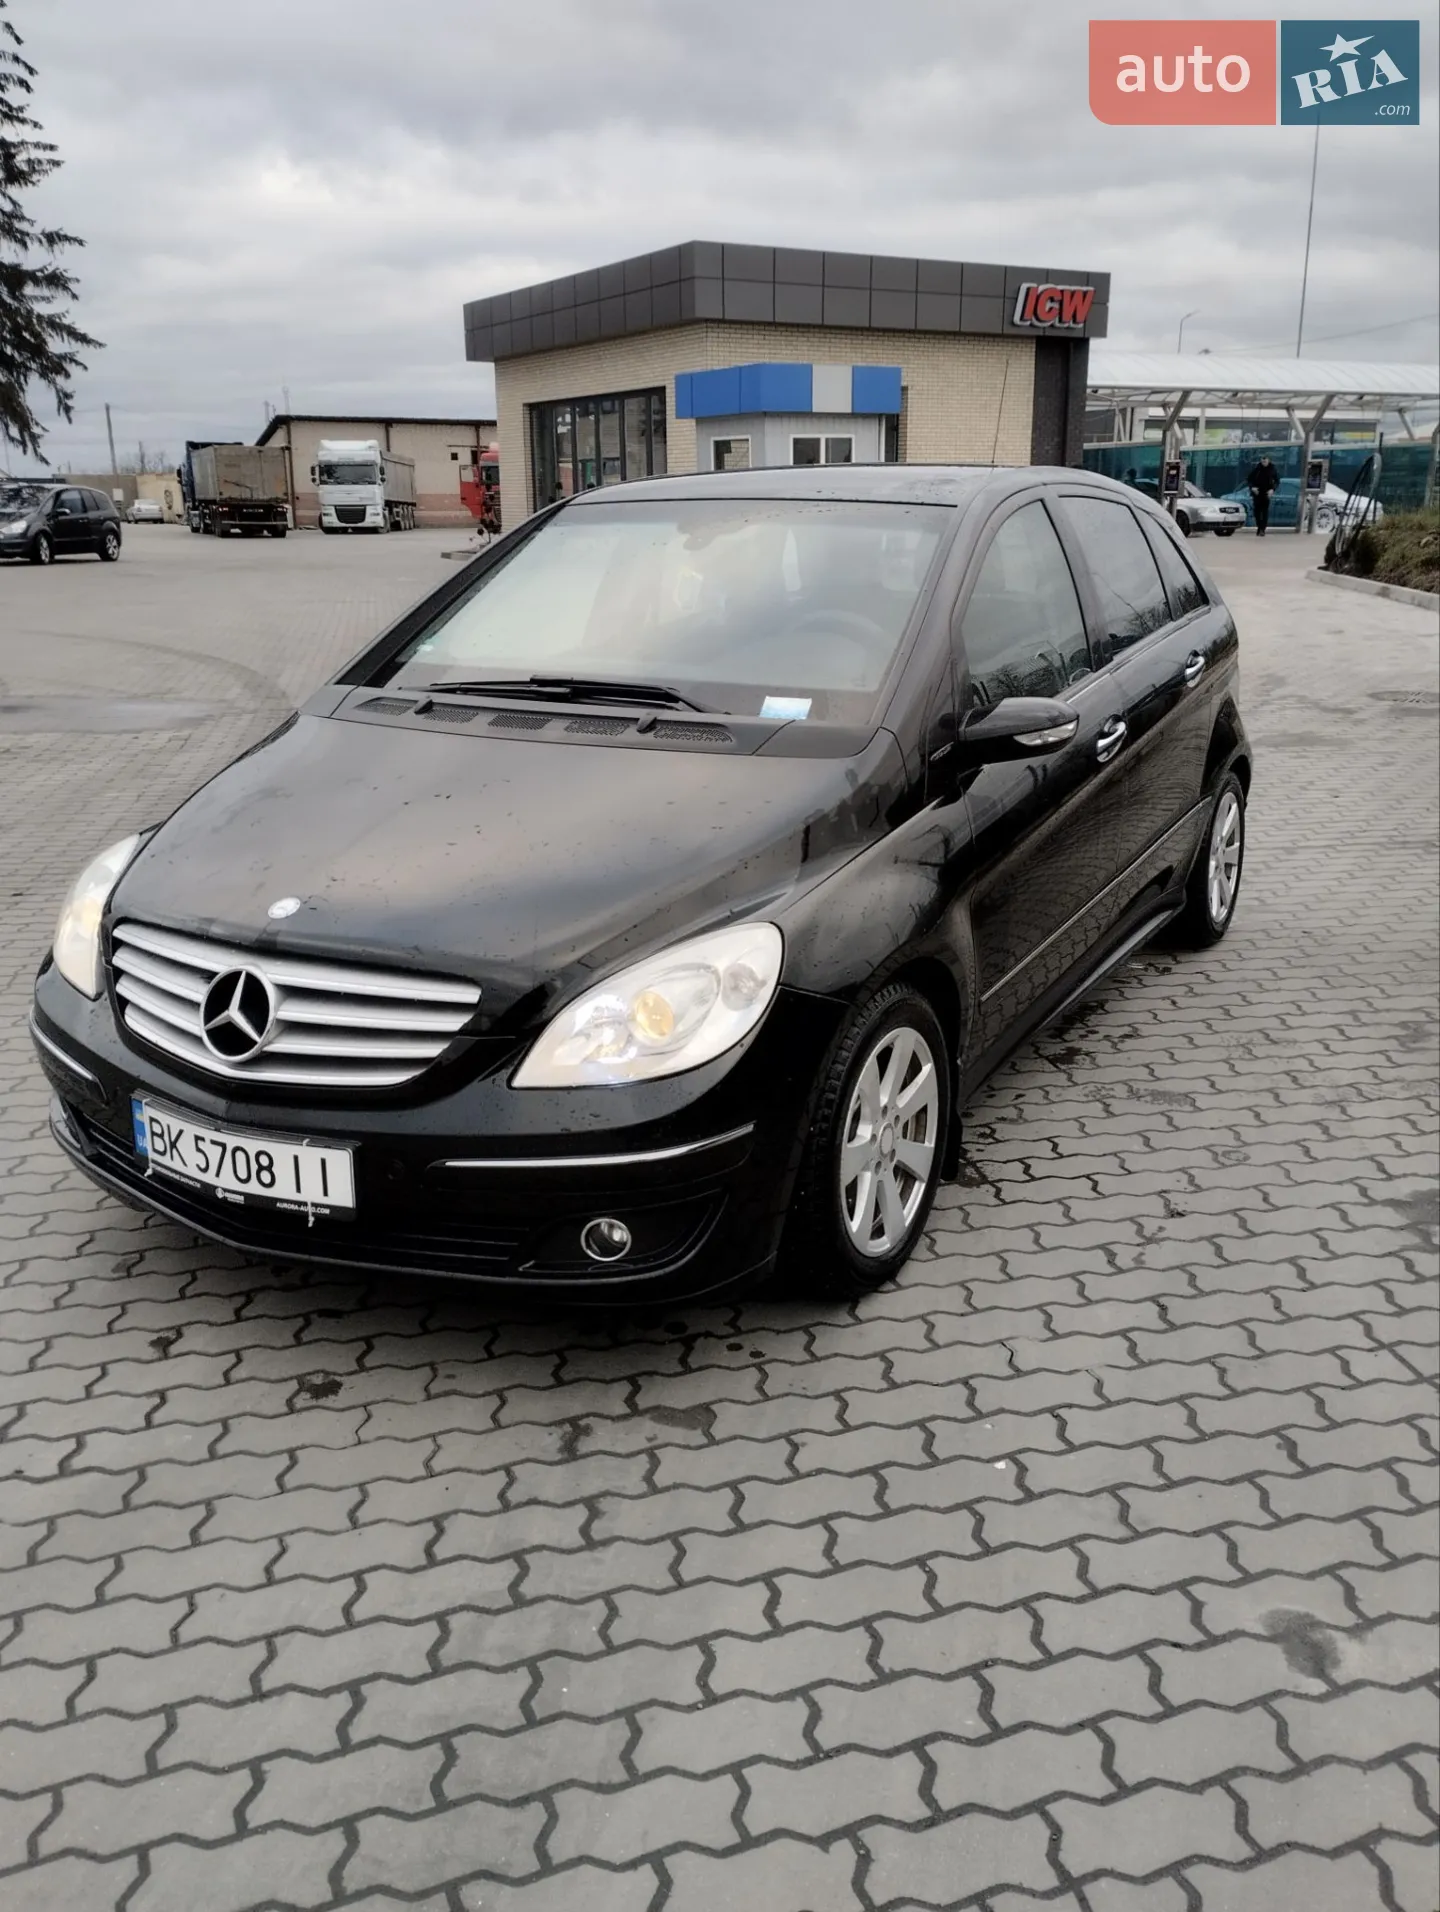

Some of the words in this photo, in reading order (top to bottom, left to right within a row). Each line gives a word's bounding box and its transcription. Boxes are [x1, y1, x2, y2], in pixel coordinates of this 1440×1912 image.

[1016, 284, 1095, 326] ICW
[149, 1115, 188, 1168] BK
[193, 1134, 277, 1189] 5708
[276, 1201, 330, 1215] AURORA-AUO.COM
